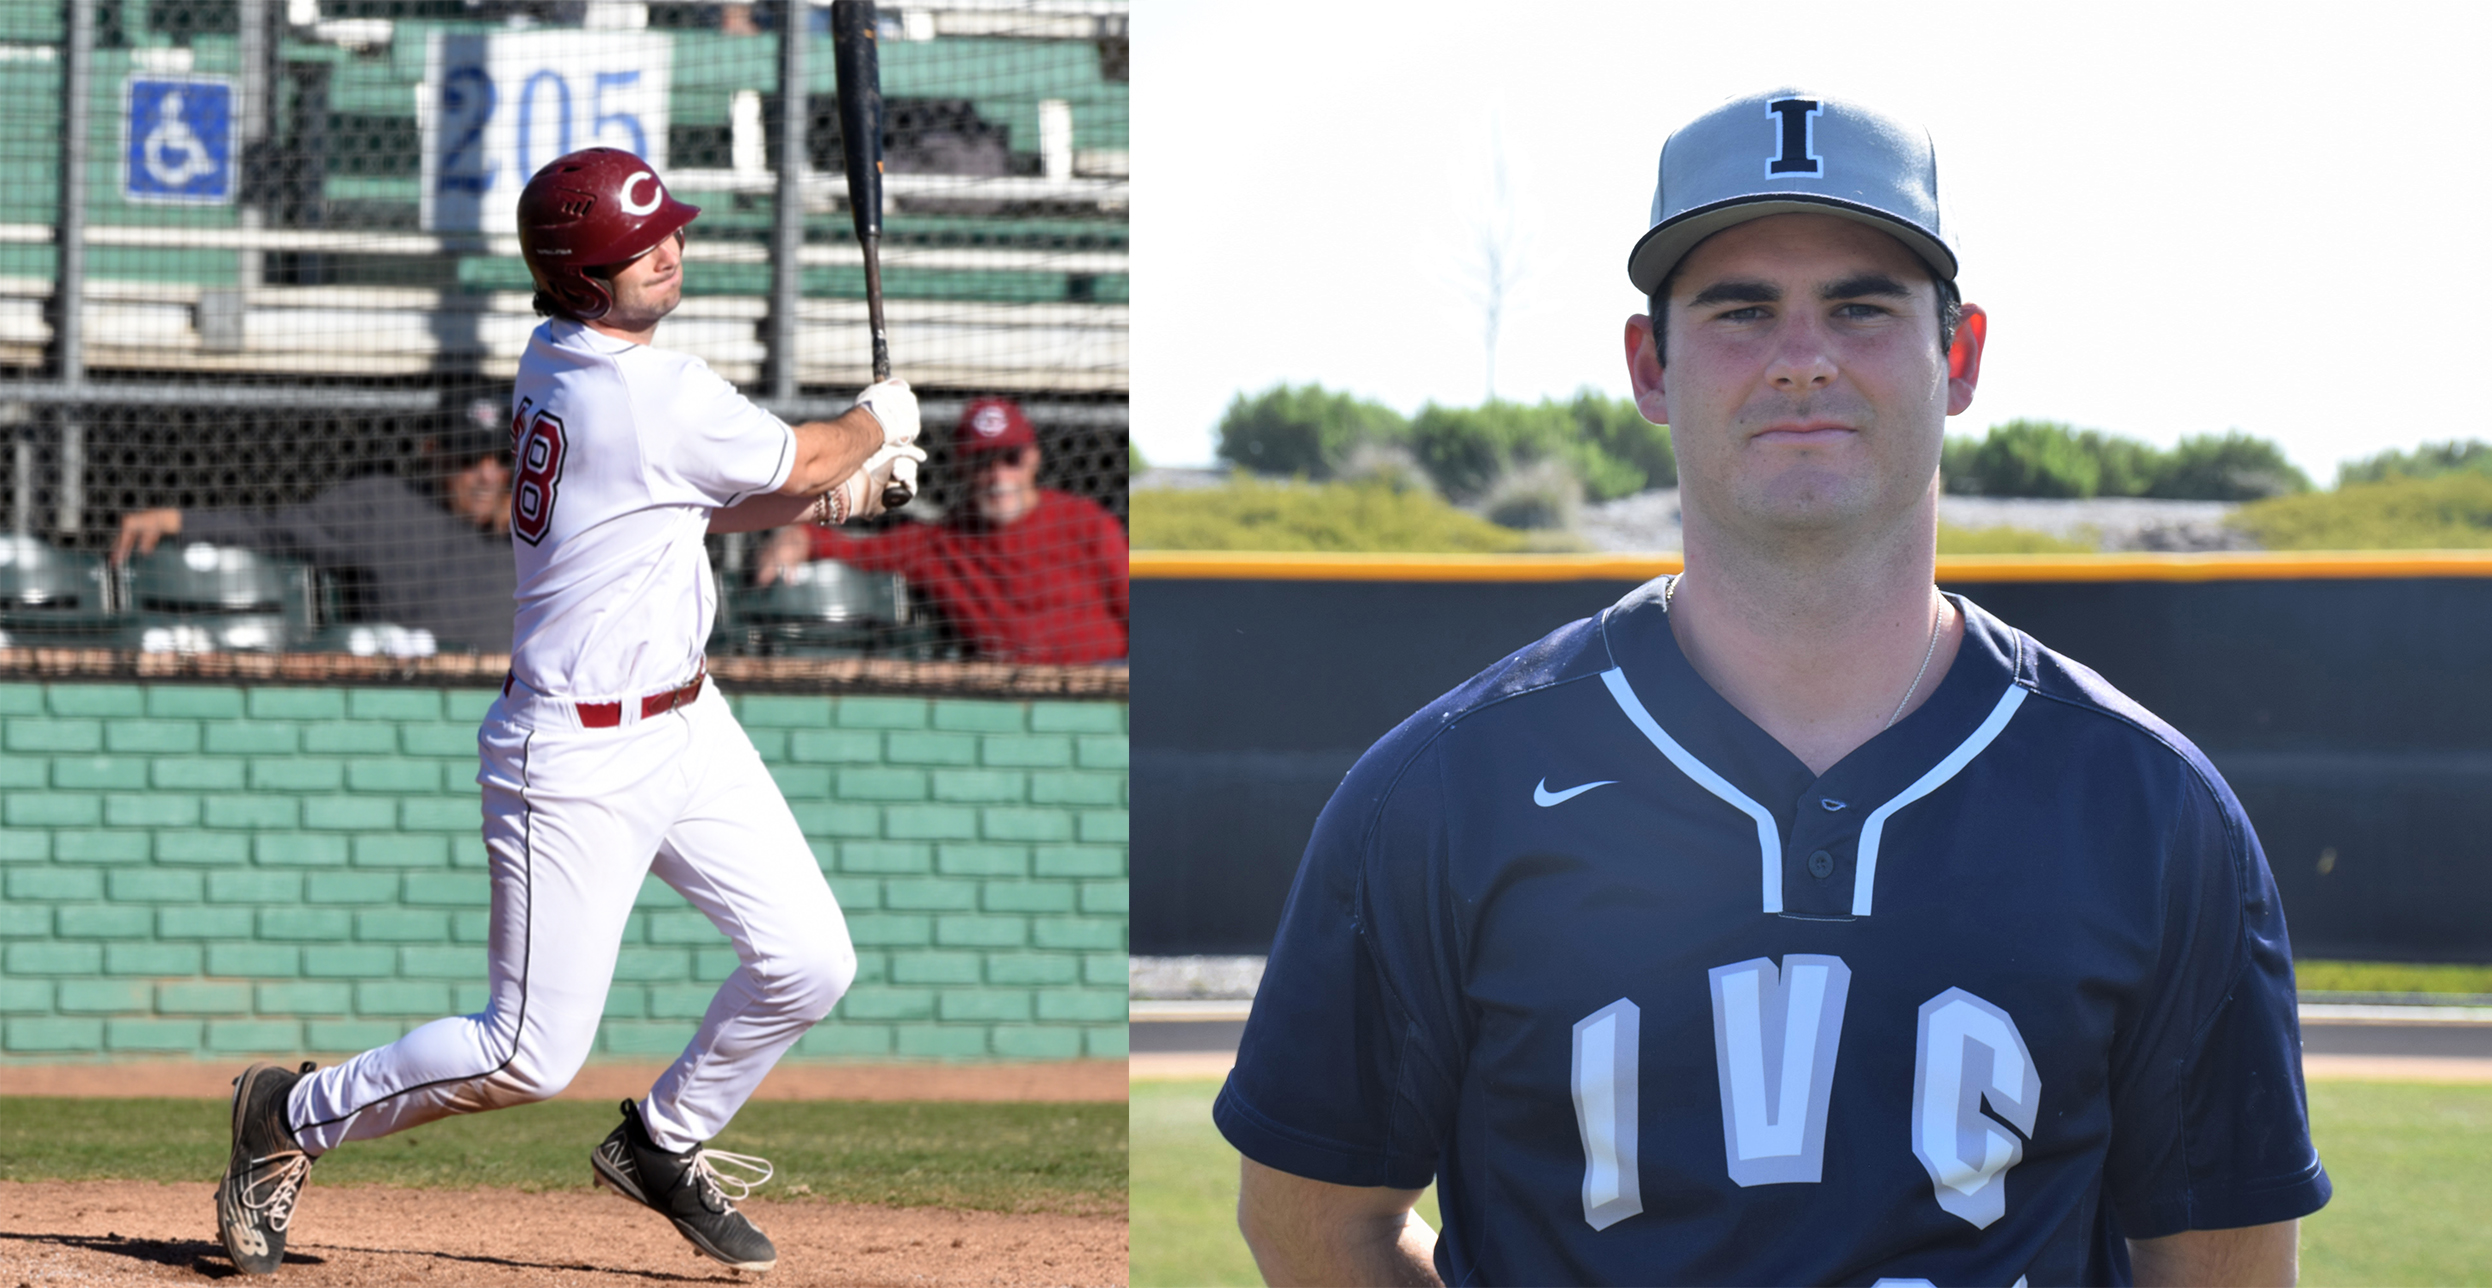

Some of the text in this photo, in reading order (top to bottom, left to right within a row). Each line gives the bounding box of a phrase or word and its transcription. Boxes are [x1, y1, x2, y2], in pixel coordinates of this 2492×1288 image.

[440, 65, 648, 192] 205
[1765, 96, 1823, 180] I
[620, 171, 663, 216] C
[1571, 954, 2042, 1232] IVC
